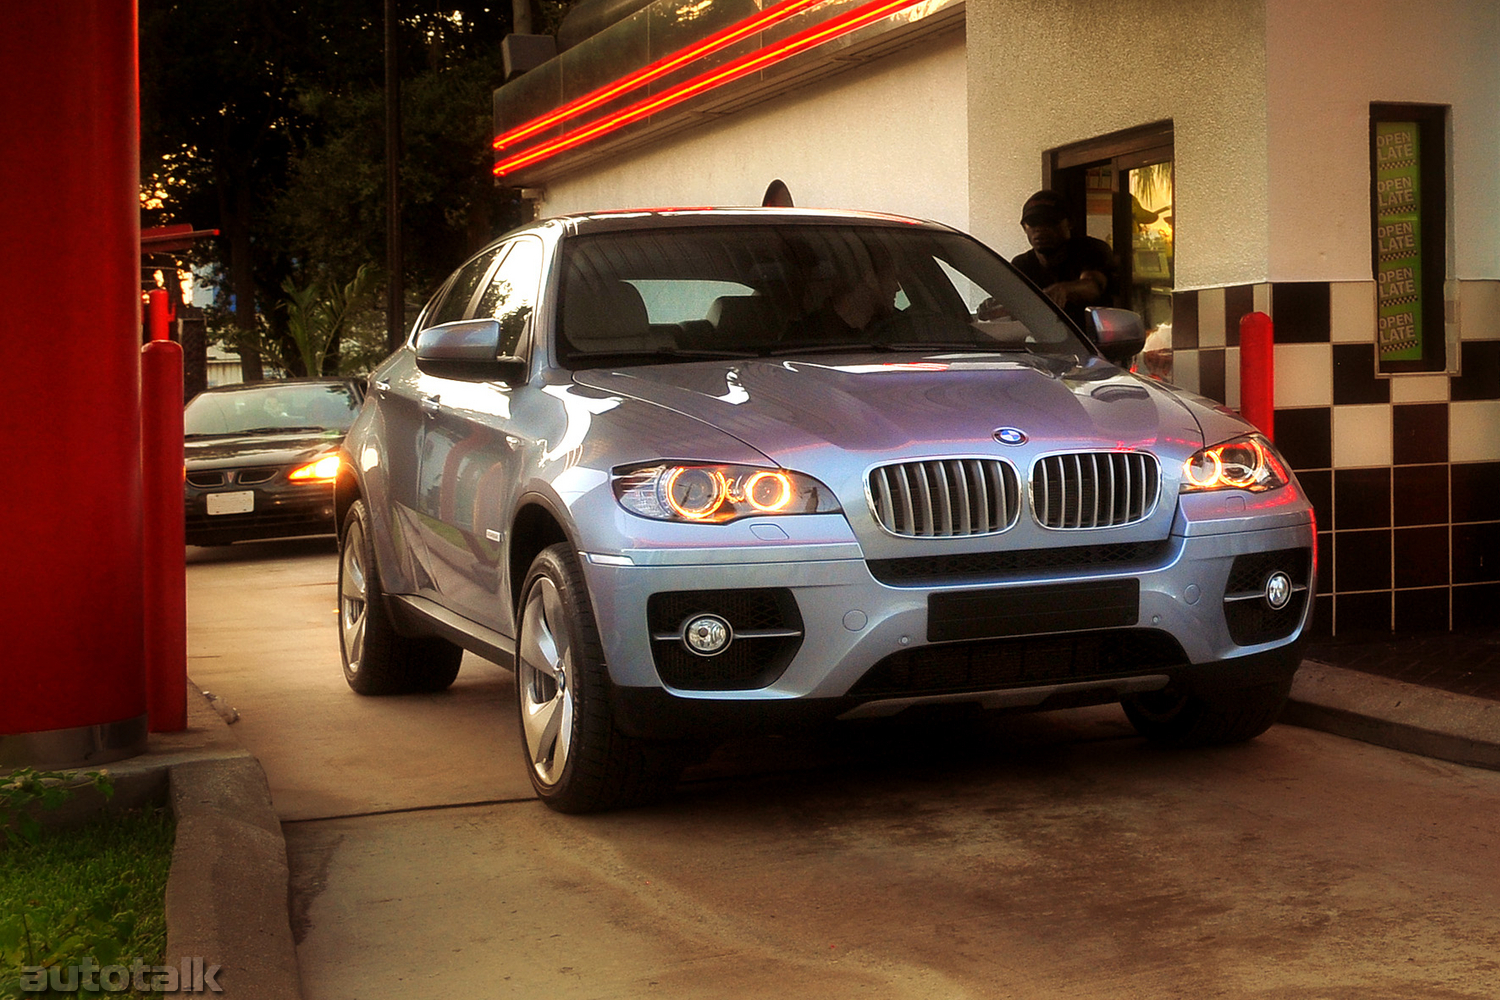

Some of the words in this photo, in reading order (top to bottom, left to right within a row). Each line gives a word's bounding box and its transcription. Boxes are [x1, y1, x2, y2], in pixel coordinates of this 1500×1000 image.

[1376, 131, 1411, 147] OPEN
[1376, 143, 1413, 161] LATE
[1377, 177, 1412, 193] OPEN
[1378, 189, 1414, 207] LATE
[1377, 222, 1413, 239] OPEN
[1378, 234, 1415, 252] LATE
[1378, 267, 1413, 284] OPEN
[1379, 279, 1415, 299] LATE
[1379, 312, 1414, 330] OPEN
[1380, 325, 1416, 344] LATE
